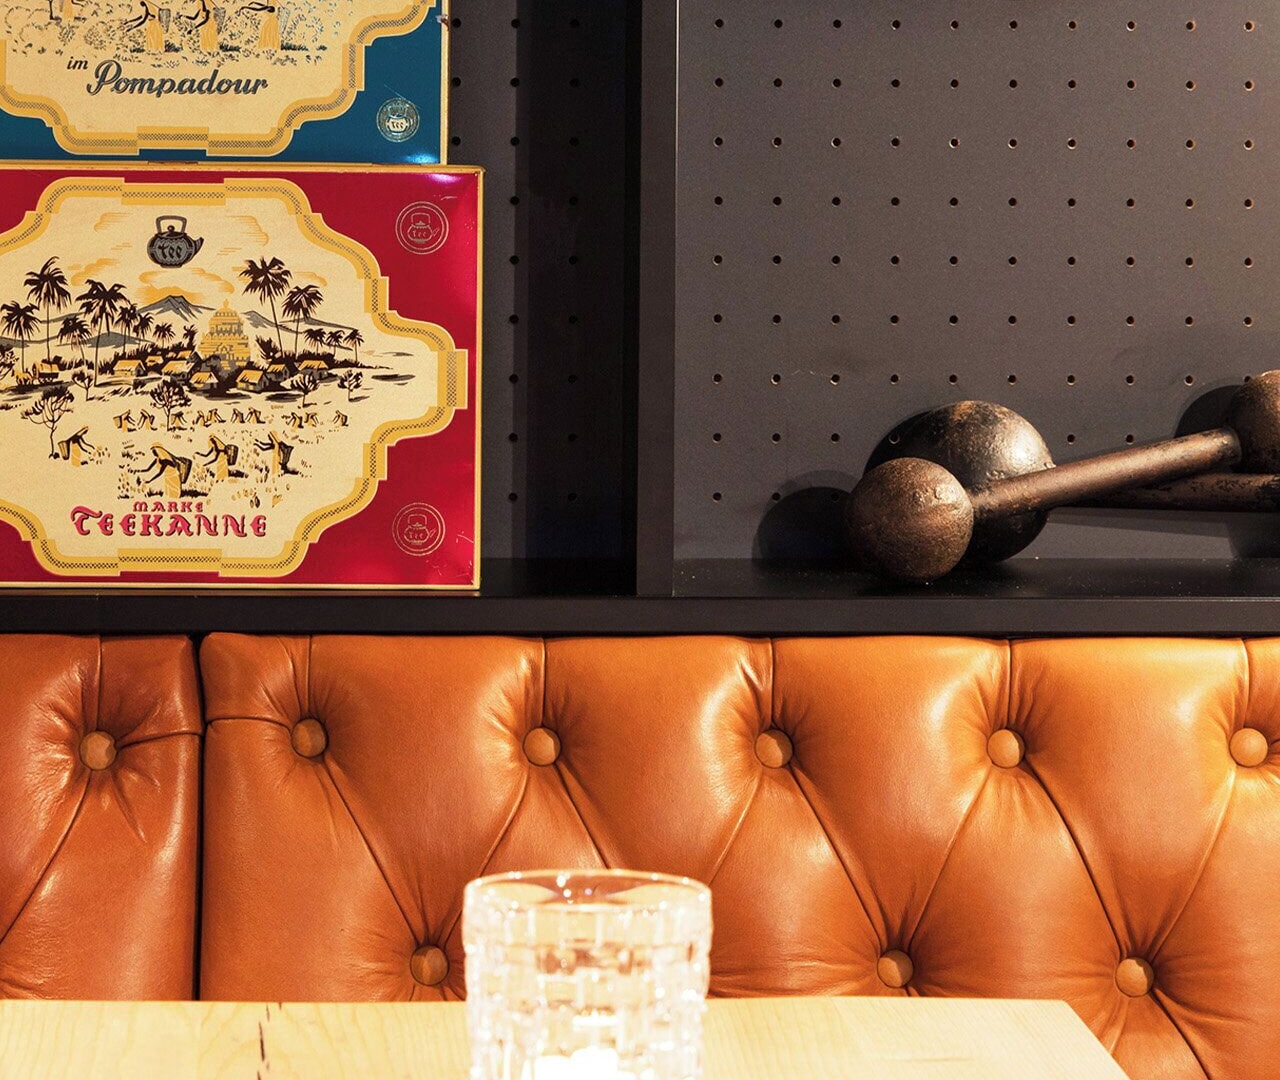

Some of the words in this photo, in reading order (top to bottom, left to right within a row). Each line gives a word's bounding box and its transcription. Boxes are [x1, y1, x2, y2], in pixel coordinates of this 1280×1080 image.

[66, 56, 88, 70] im
[86, 58, 269, 98] Pompadour
[70, 506, 267, 538] TEEKANNE
[133, 501, 203, 513] MARKE
